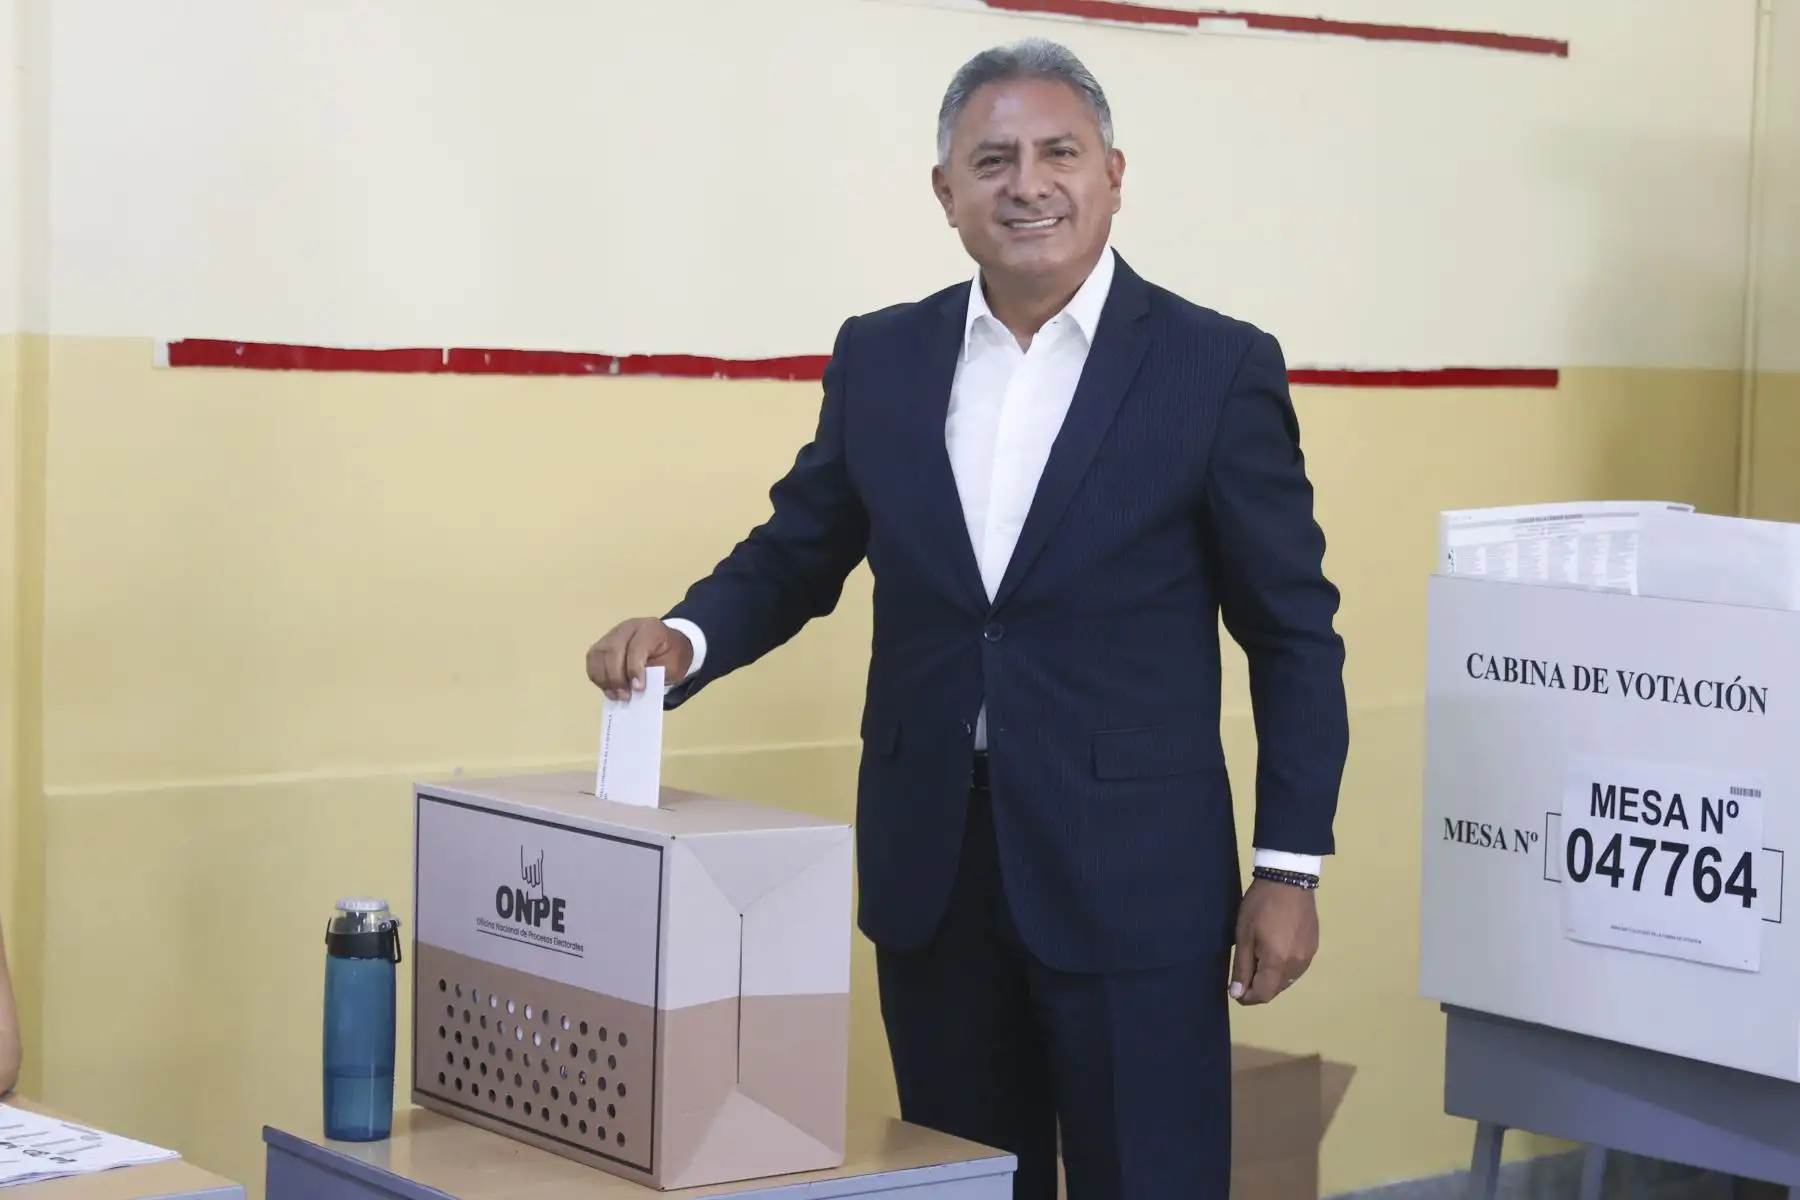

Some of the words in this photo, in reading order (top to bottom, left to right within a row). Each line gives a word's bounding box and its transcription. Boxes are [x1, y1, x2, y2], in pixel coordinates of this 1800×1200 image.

[1466, 652, 1566, 690] CABINA
[1572, 664, 1609, 695] DE
[1616, 670, 1768, 716] VOTACIÓN
[1589, 782, 1689, 831] MESA
[1443, 817, 1508, 851] MESA
[1566, 827, 1758, 909] 047764
[495, 885, 566, 934] ONPE
[476, 917, 495, 930] Oficina
[496, 923, 520, 936] Nacional
[520, 928, 527, 938] de
[528, 931, 553, 945] Procesos
[553, 937, 584, 953] Electorales
